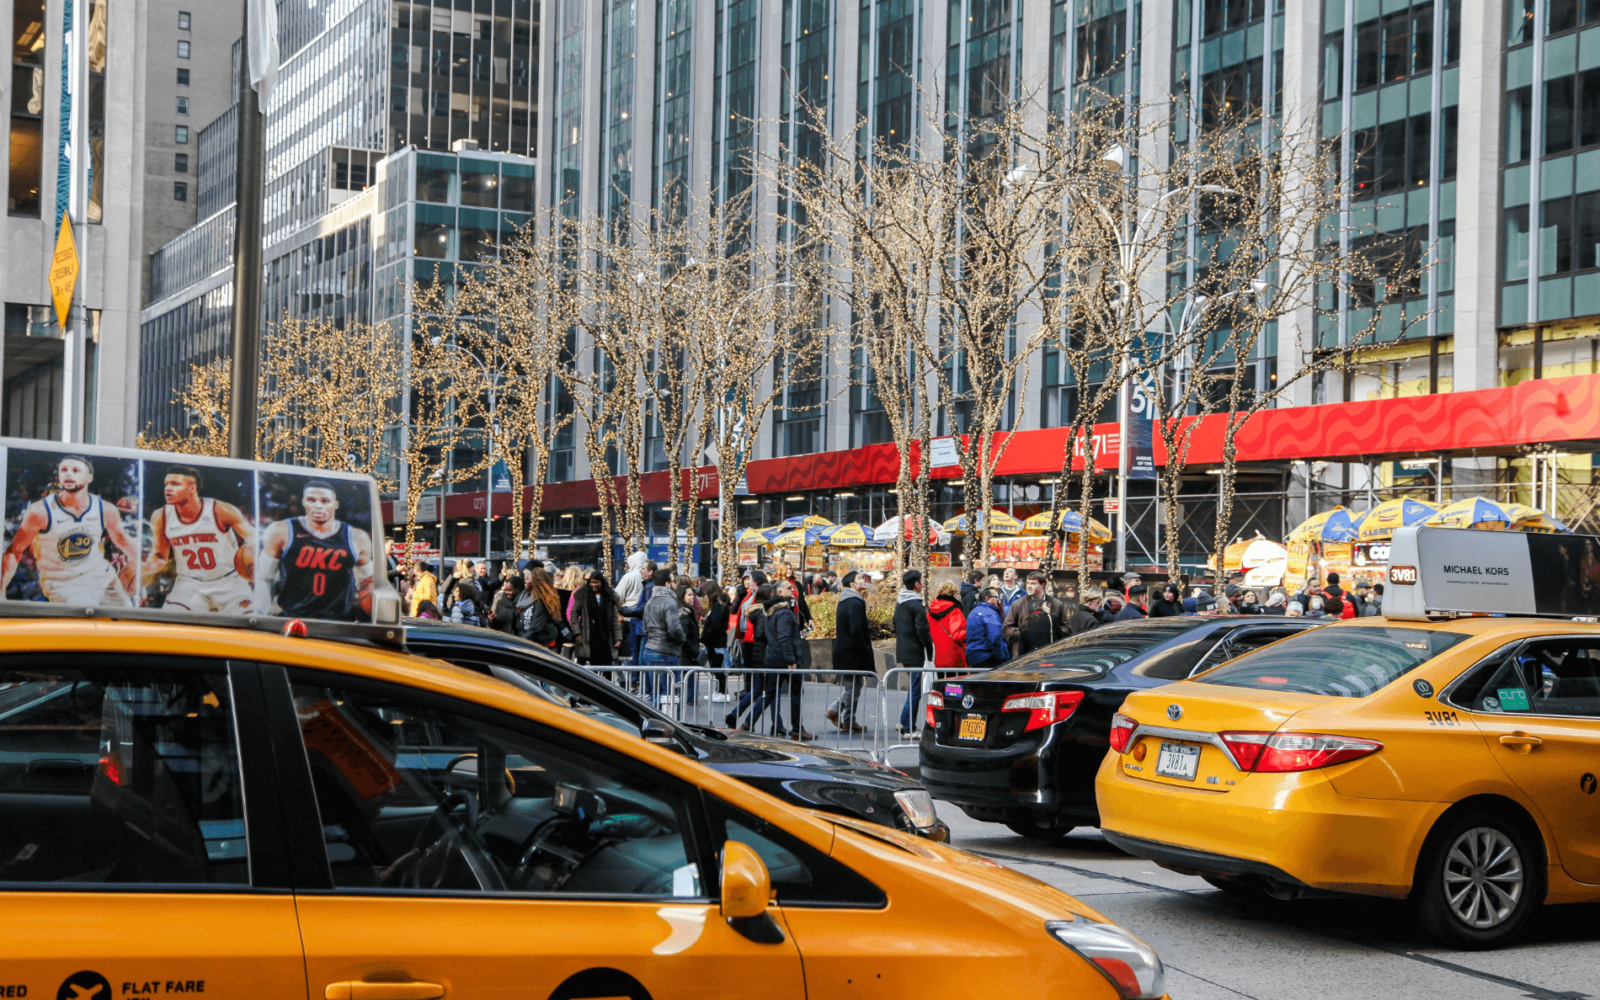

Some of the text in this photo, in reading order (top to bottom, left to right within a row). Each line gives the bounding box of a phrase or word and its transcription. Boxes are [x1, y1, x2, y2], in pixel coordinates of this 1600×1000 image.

[1362, 527, 1394, 537] SABRET
[75, 537, 91, 546] 30
[182, 547, 216, 570] 20
[295, 545, 347, 571] OKC
[1390, 568, 1417, 582] 3V81
[1443, 565, 1509, 576] MICHAEL KORS
[313, 572, 326, 596] 0
[1498, 689, 1526, 700] curb
[1424, 711, 1462, 726] 3V81
[122, 980, 205, 995] FLAT FARE
